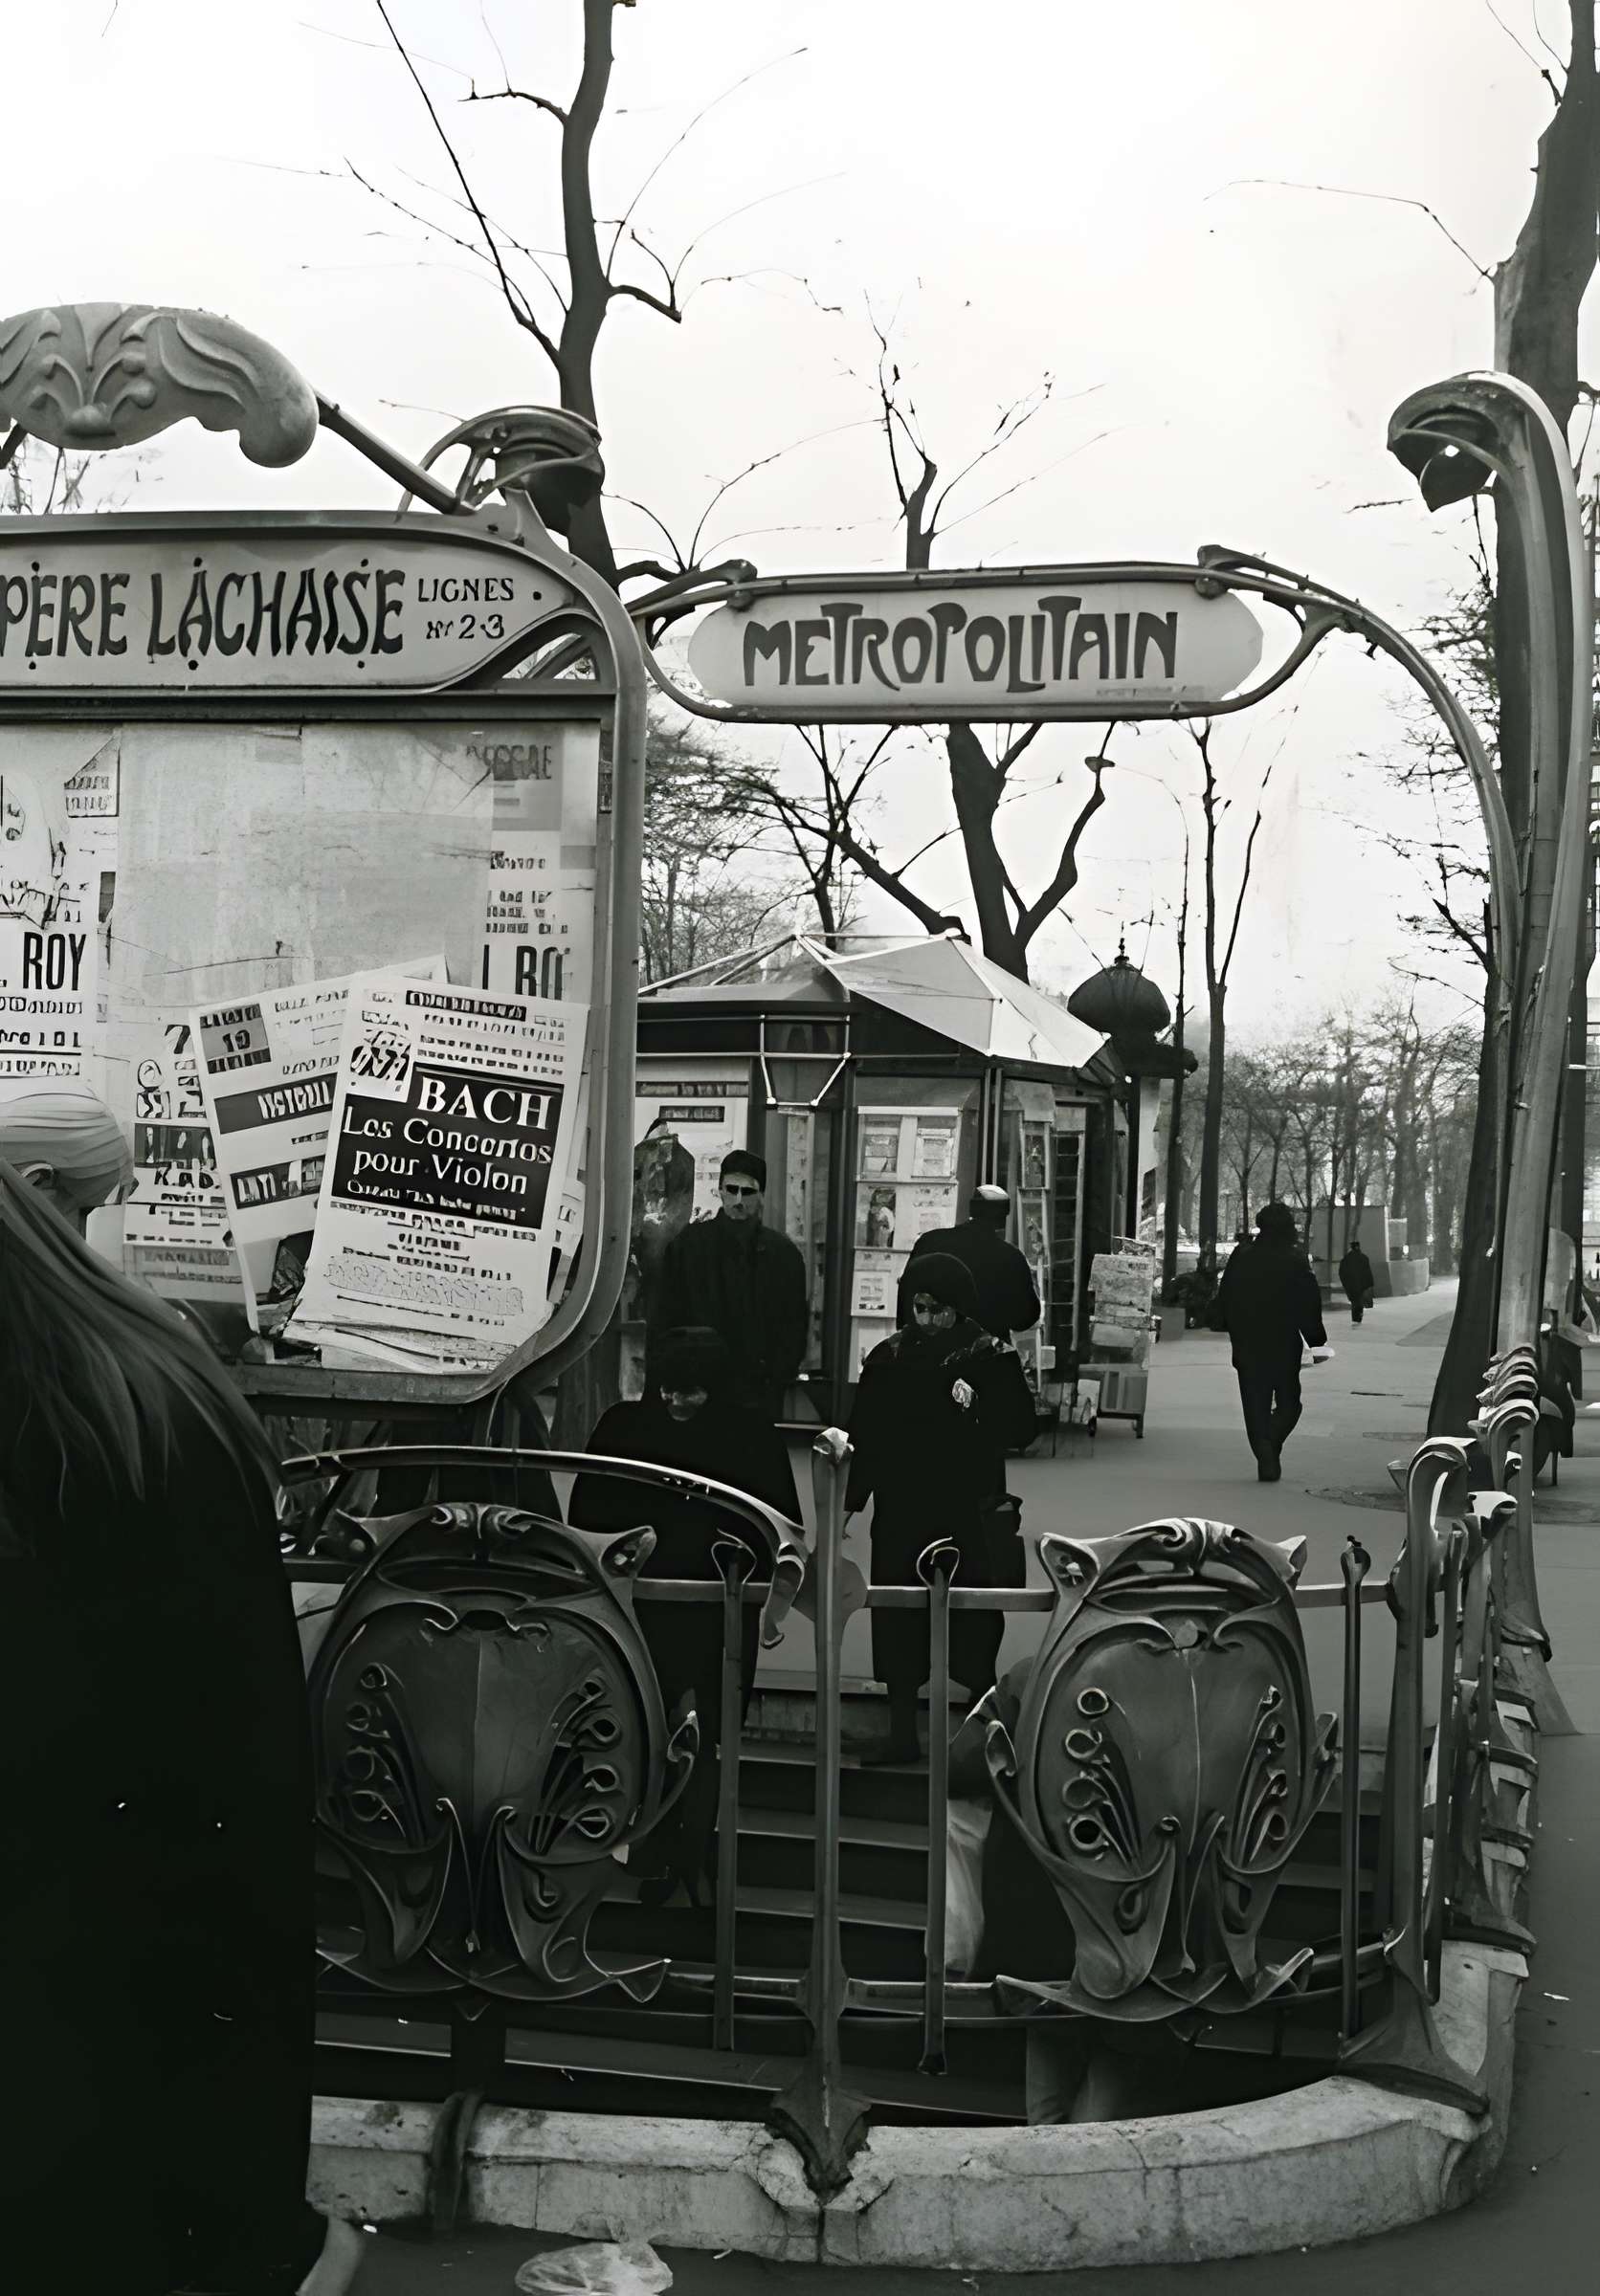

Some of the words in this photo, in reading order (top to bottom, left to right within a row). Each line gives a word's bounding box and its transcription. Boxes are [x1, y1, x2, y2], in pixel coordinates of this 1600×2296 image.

[147, 568, 406, 662] LACHAISE
[418, 577, 515, 603] LIGNES
[742, 595, 1179, 694] METROPOLITAIN
[22, 931, 87, 991] ROY
[417, 1075, 552, 1131] BACH
[353, 1150, 420, 1175] pour
[432, 1154, 528, 1195] Violon
